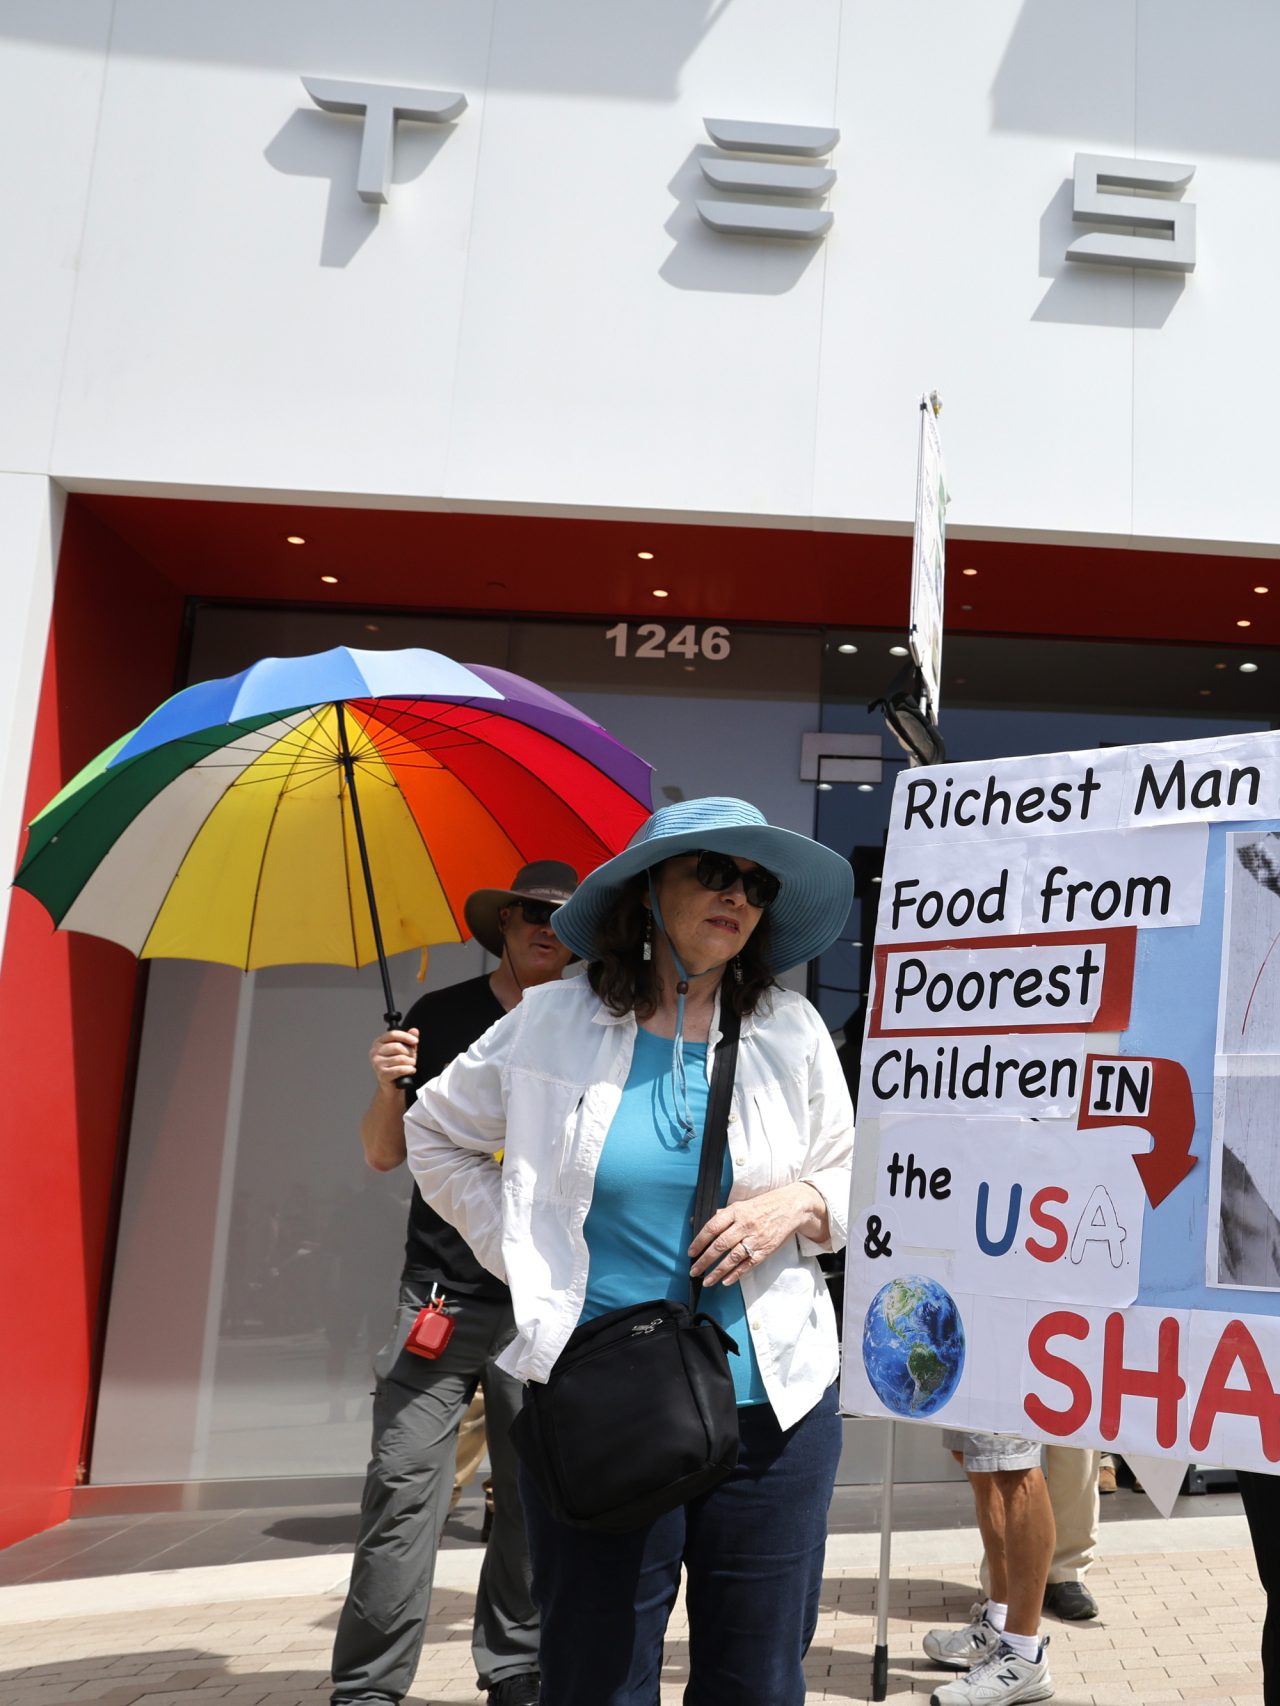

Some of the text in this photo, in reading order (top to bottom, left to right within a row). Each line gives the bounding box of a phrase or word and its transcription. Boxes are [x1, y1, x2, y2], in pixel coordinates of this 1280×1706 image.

[605, 622, 731, 661] 1246
[903, 766, 1102, 831] Richest
[1133, 759, 1261, 816] Man
[890, 864, 1171, 930] Food from
[893, 949, 1101, 1014] Poorest
[871, 1044, 1150, 1114] Children IN
[886, 1152, 952, 1201] the
[863, 1214, 893, 1259] &
